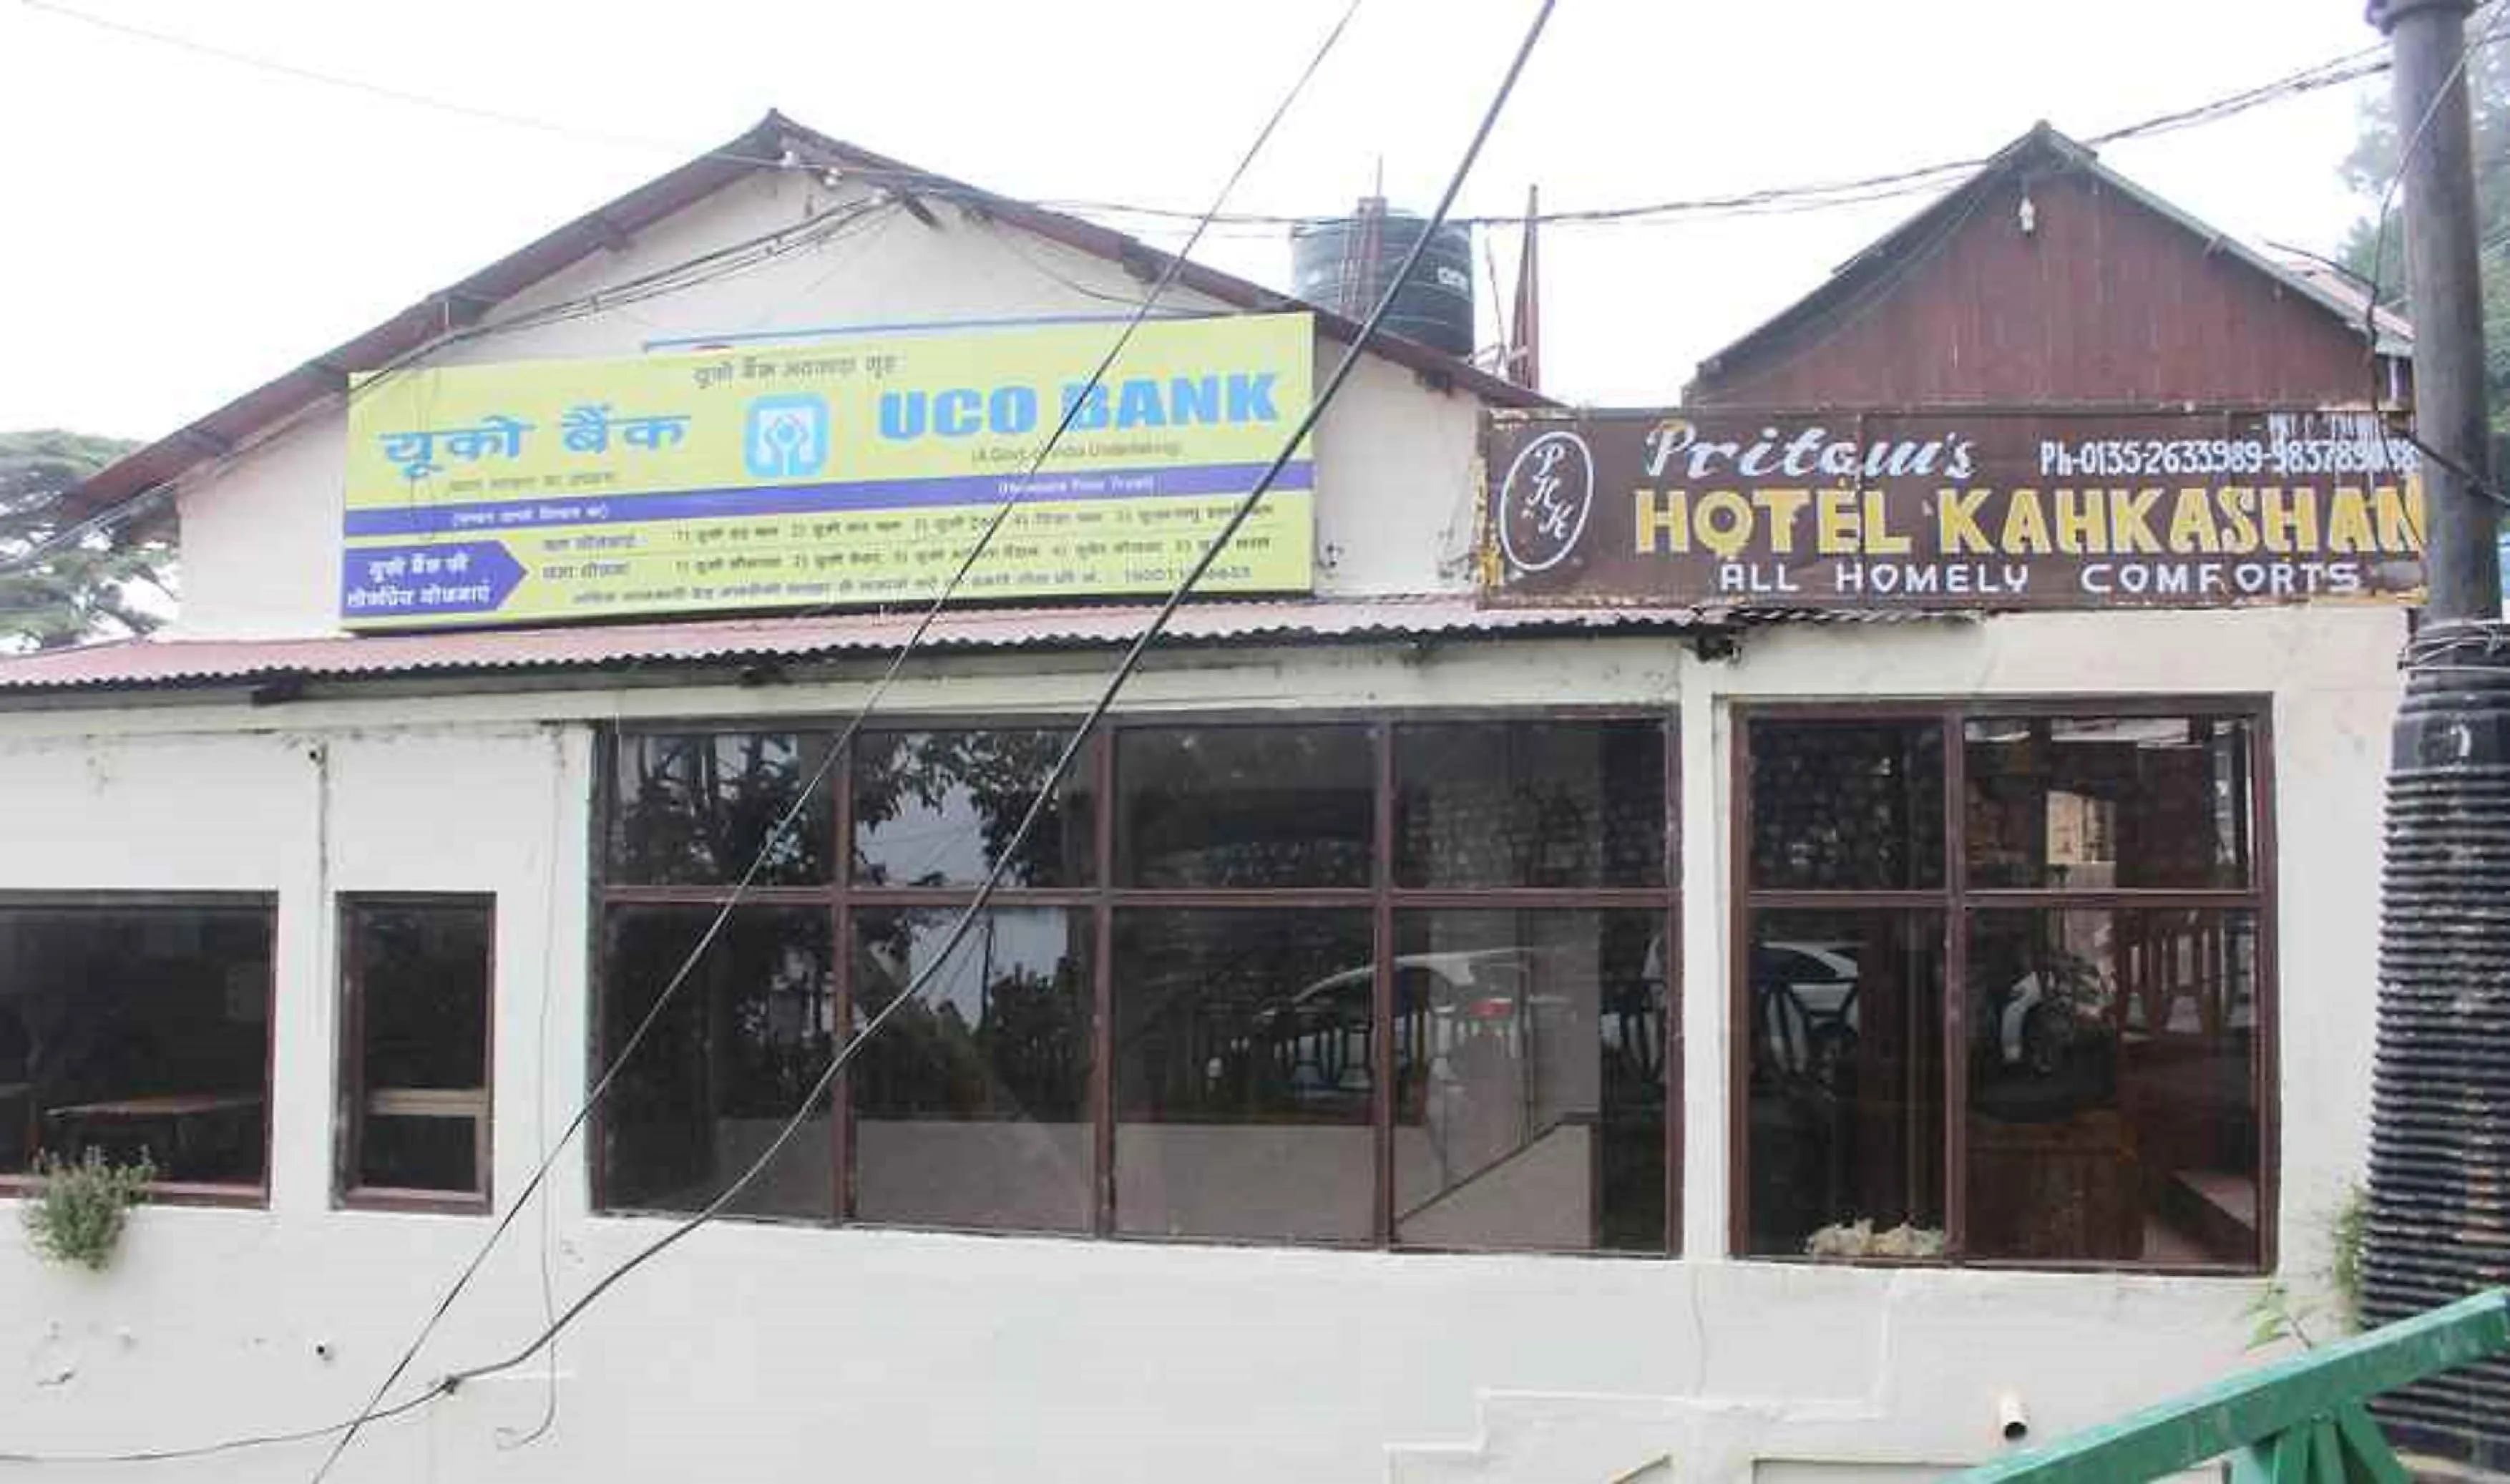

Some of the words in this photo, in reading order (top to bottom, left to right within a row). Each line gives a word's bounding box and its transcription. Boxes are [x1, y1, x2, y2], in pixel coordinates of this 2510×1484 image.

[378, 414, 537, 478] यूको
[561, 403, 693, 454] बैंक
[878, 384, 1038, 441] UCO
[1058, 372, 1281, 431] BANK
[1635, 488, 1913, 556] HOTEL
[1937, 475, 2425, 556] KAHKASHAN
[1719, 563, 1801, 593] ALL
[1835, 562, 2029, 593] HOMELY
[2080, 561, 2361, 594] COMFORTS
